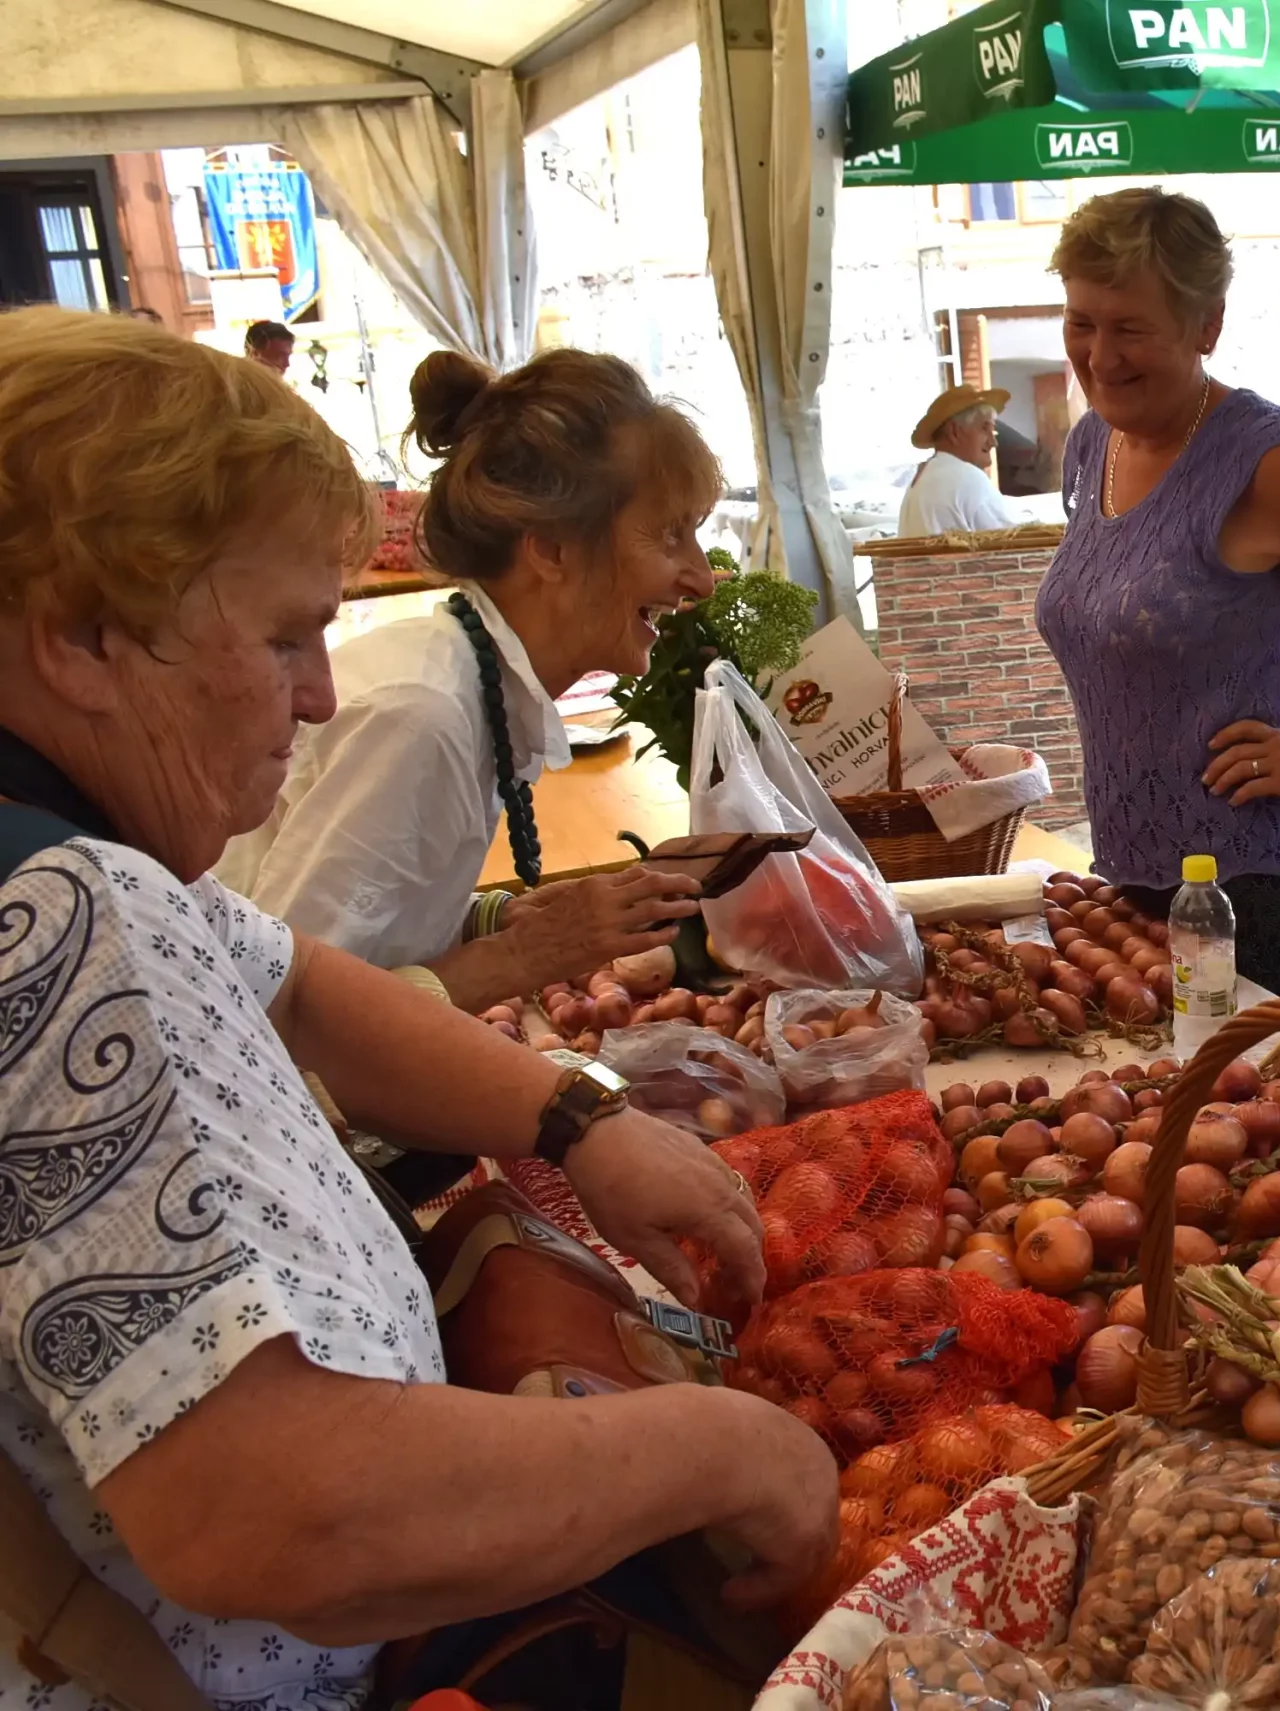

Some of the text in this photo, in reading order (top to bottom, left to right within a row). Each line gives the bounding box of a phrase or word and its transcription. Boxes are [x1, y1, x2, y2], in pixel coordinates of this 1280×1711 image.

[1128, 7, 1247, 49] PAN
[979, 30, 1022, 79] PAN
[893, 69, 921, 111] PAN
[851, 733, 890, 769] HORVA
